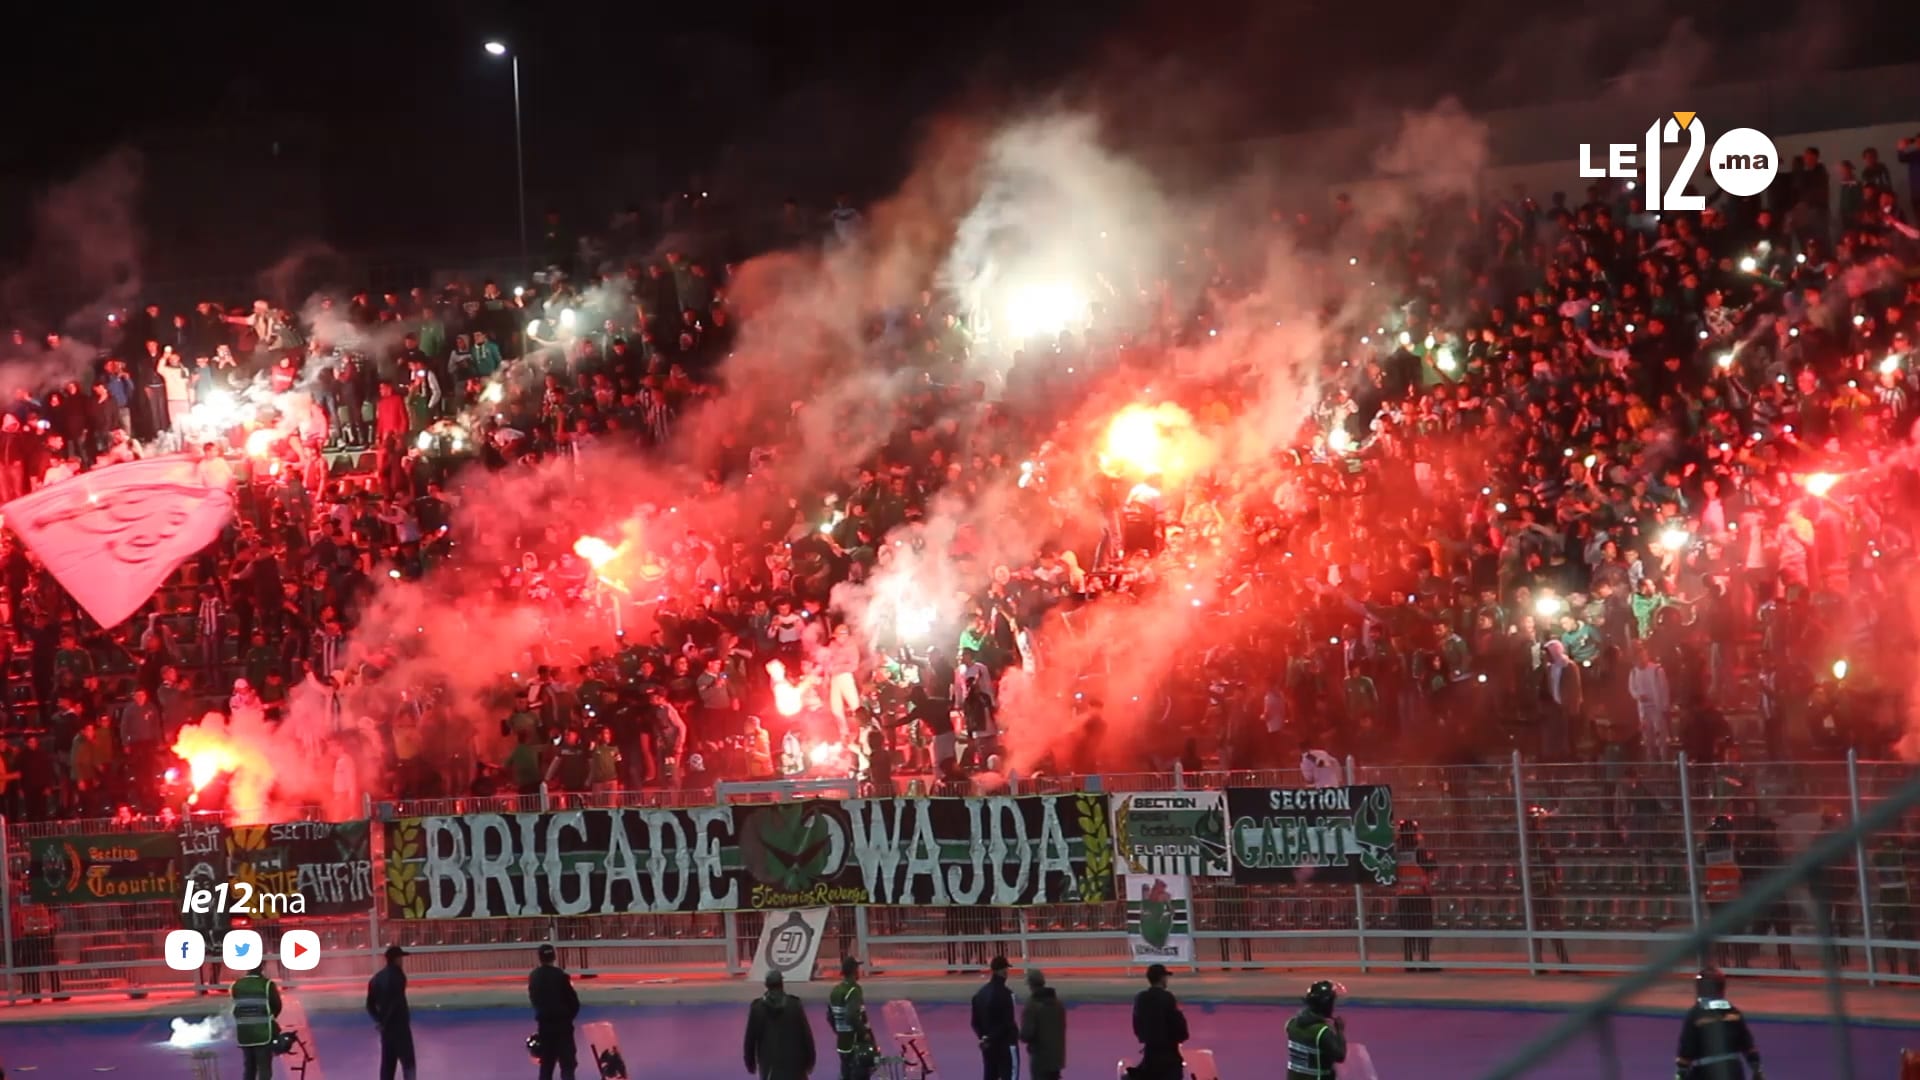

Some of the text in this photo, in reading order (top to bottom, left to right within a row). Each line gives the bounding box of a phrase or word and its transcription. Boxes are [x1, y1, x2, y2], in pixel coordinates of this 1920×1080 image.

[1134, 797, 1196, 809] SECTION
[1270, 787, 1350, 810] SECTION
[270, 821, 334, 841] SECTION
[421, 807, 738, 918] BRIGADE
